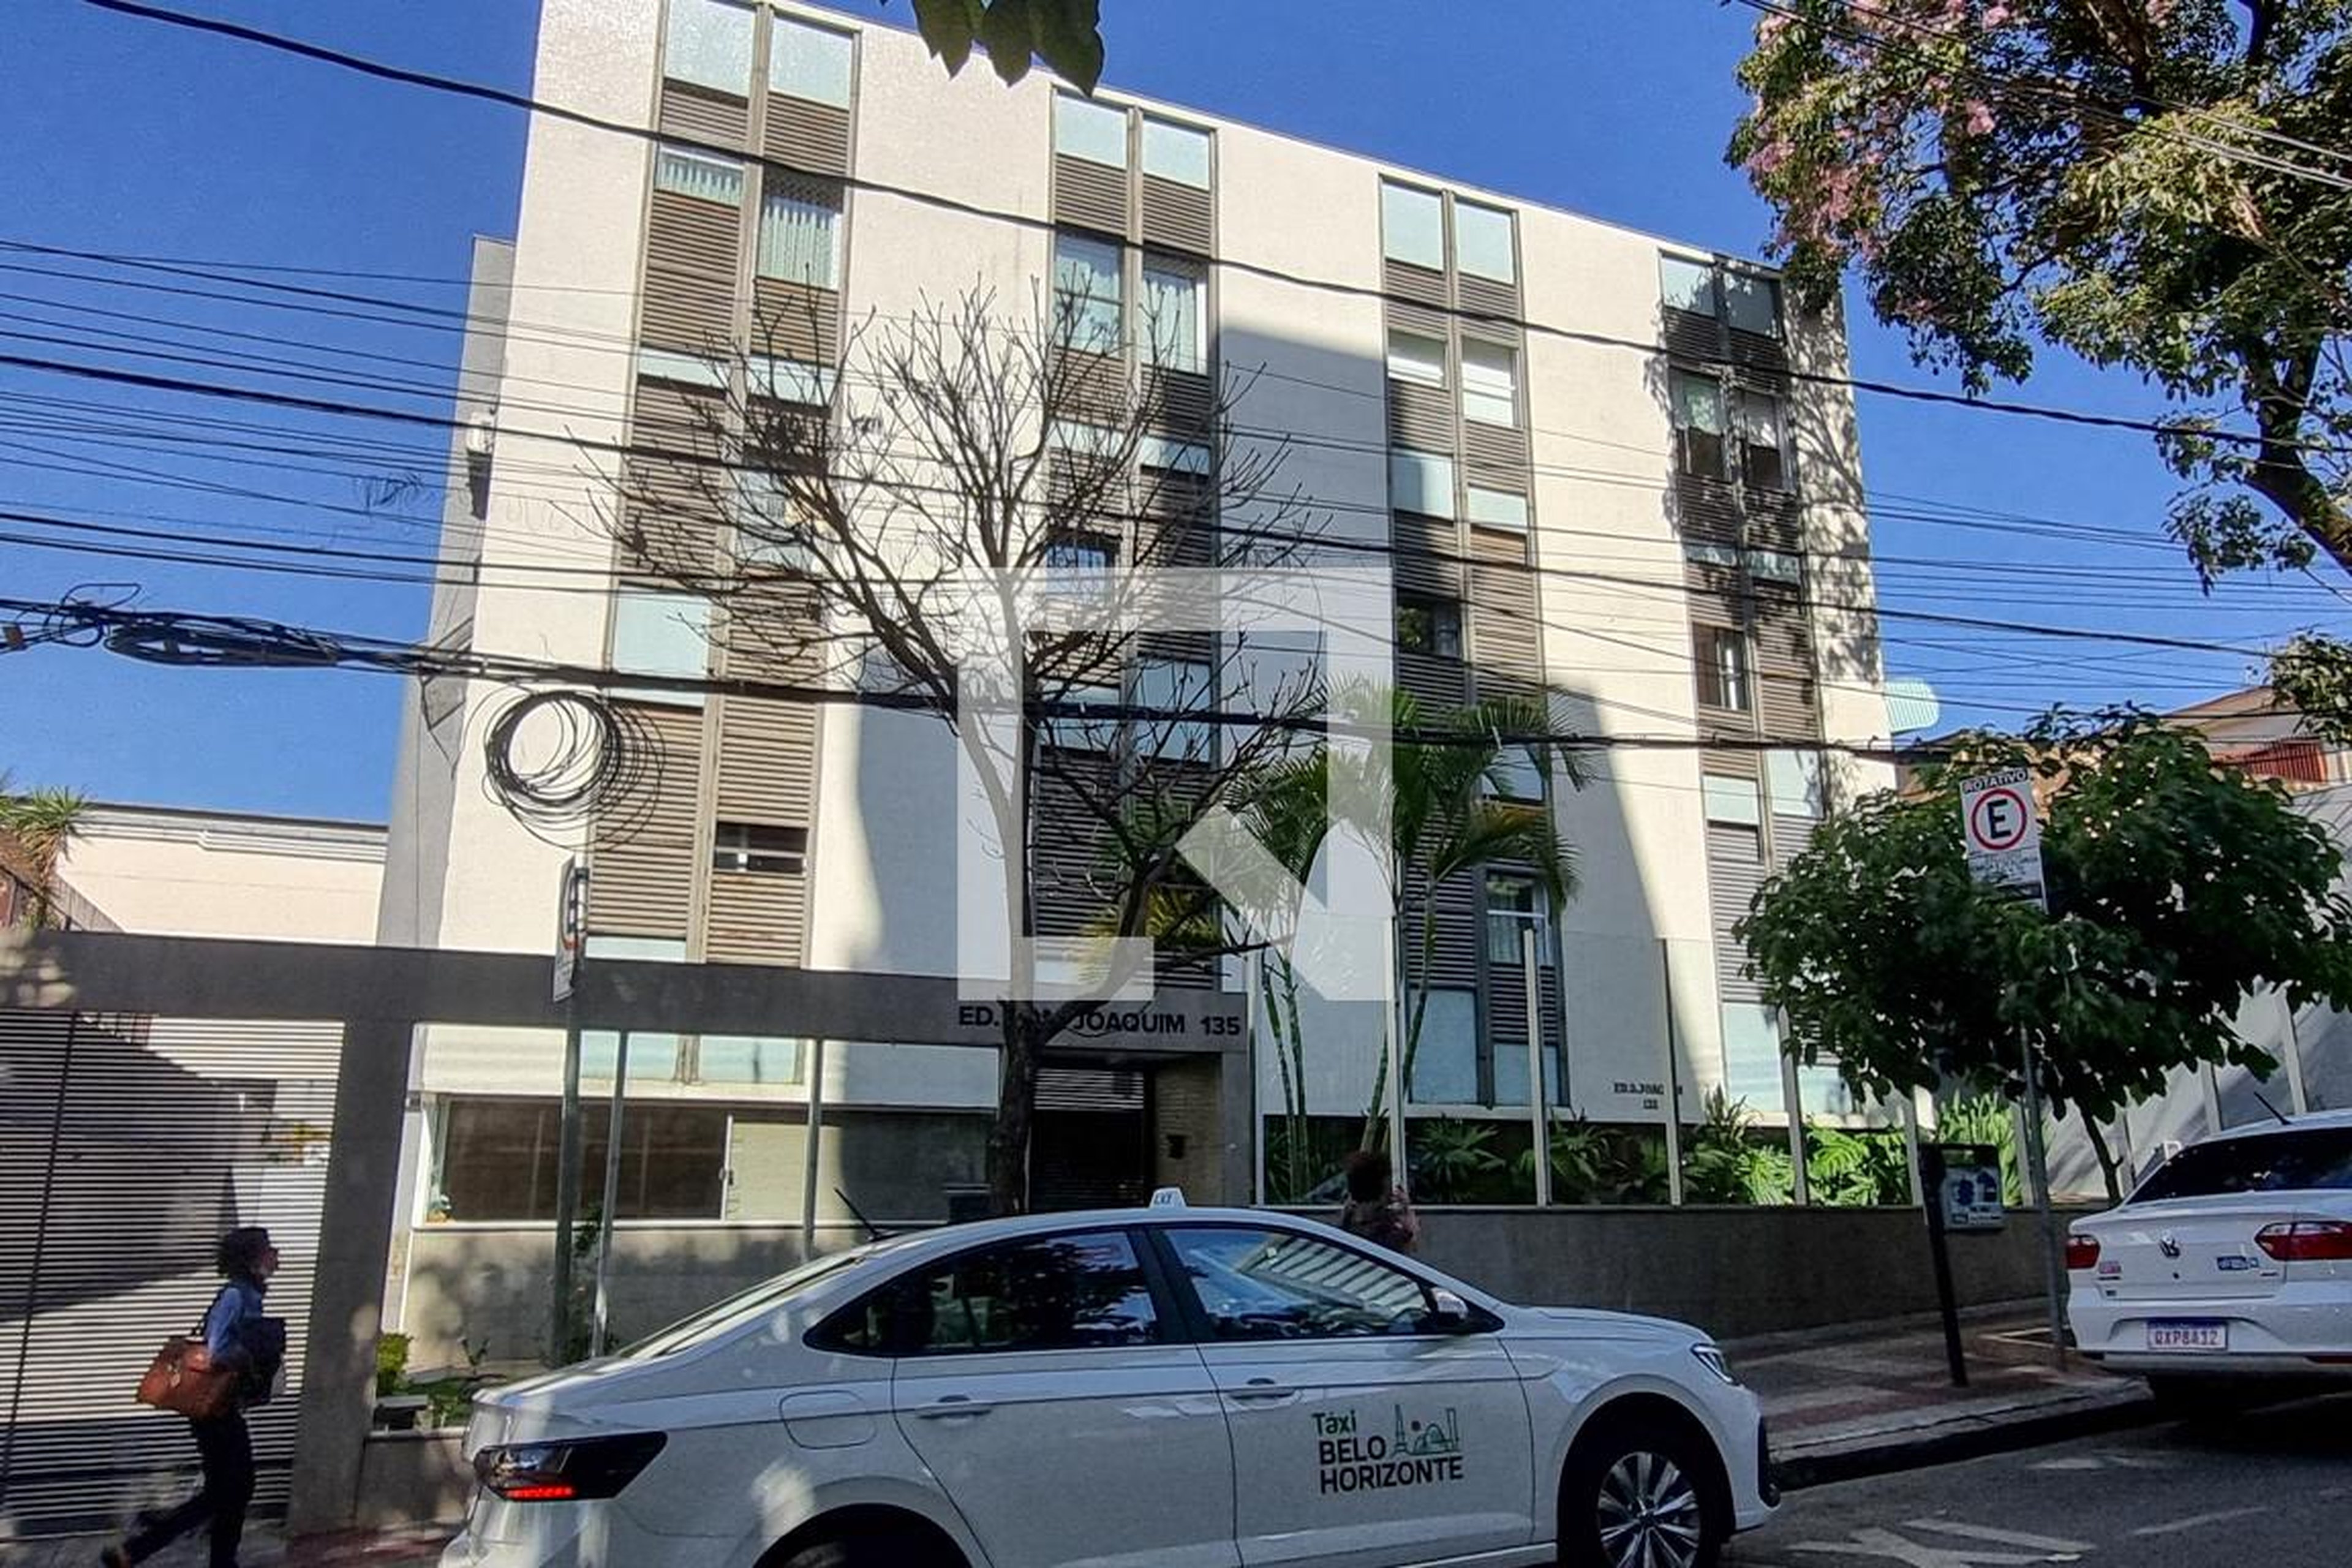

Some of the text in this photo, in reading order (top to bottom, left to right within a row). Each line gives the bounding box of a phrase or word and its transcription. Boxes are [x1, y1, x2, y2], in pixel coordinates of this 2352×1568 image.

[1987, 799, 2012, 839] E
[959, 1005, 1000, 1027] ED.
[1073, 1012, 1185, 1034] JOAQUIM
[1200, 1016, 1240, 1036] 135
[1319, 1435, 1386, 1465] BELO
[1320, 1455, 1464, 1494] HORIZONTE
